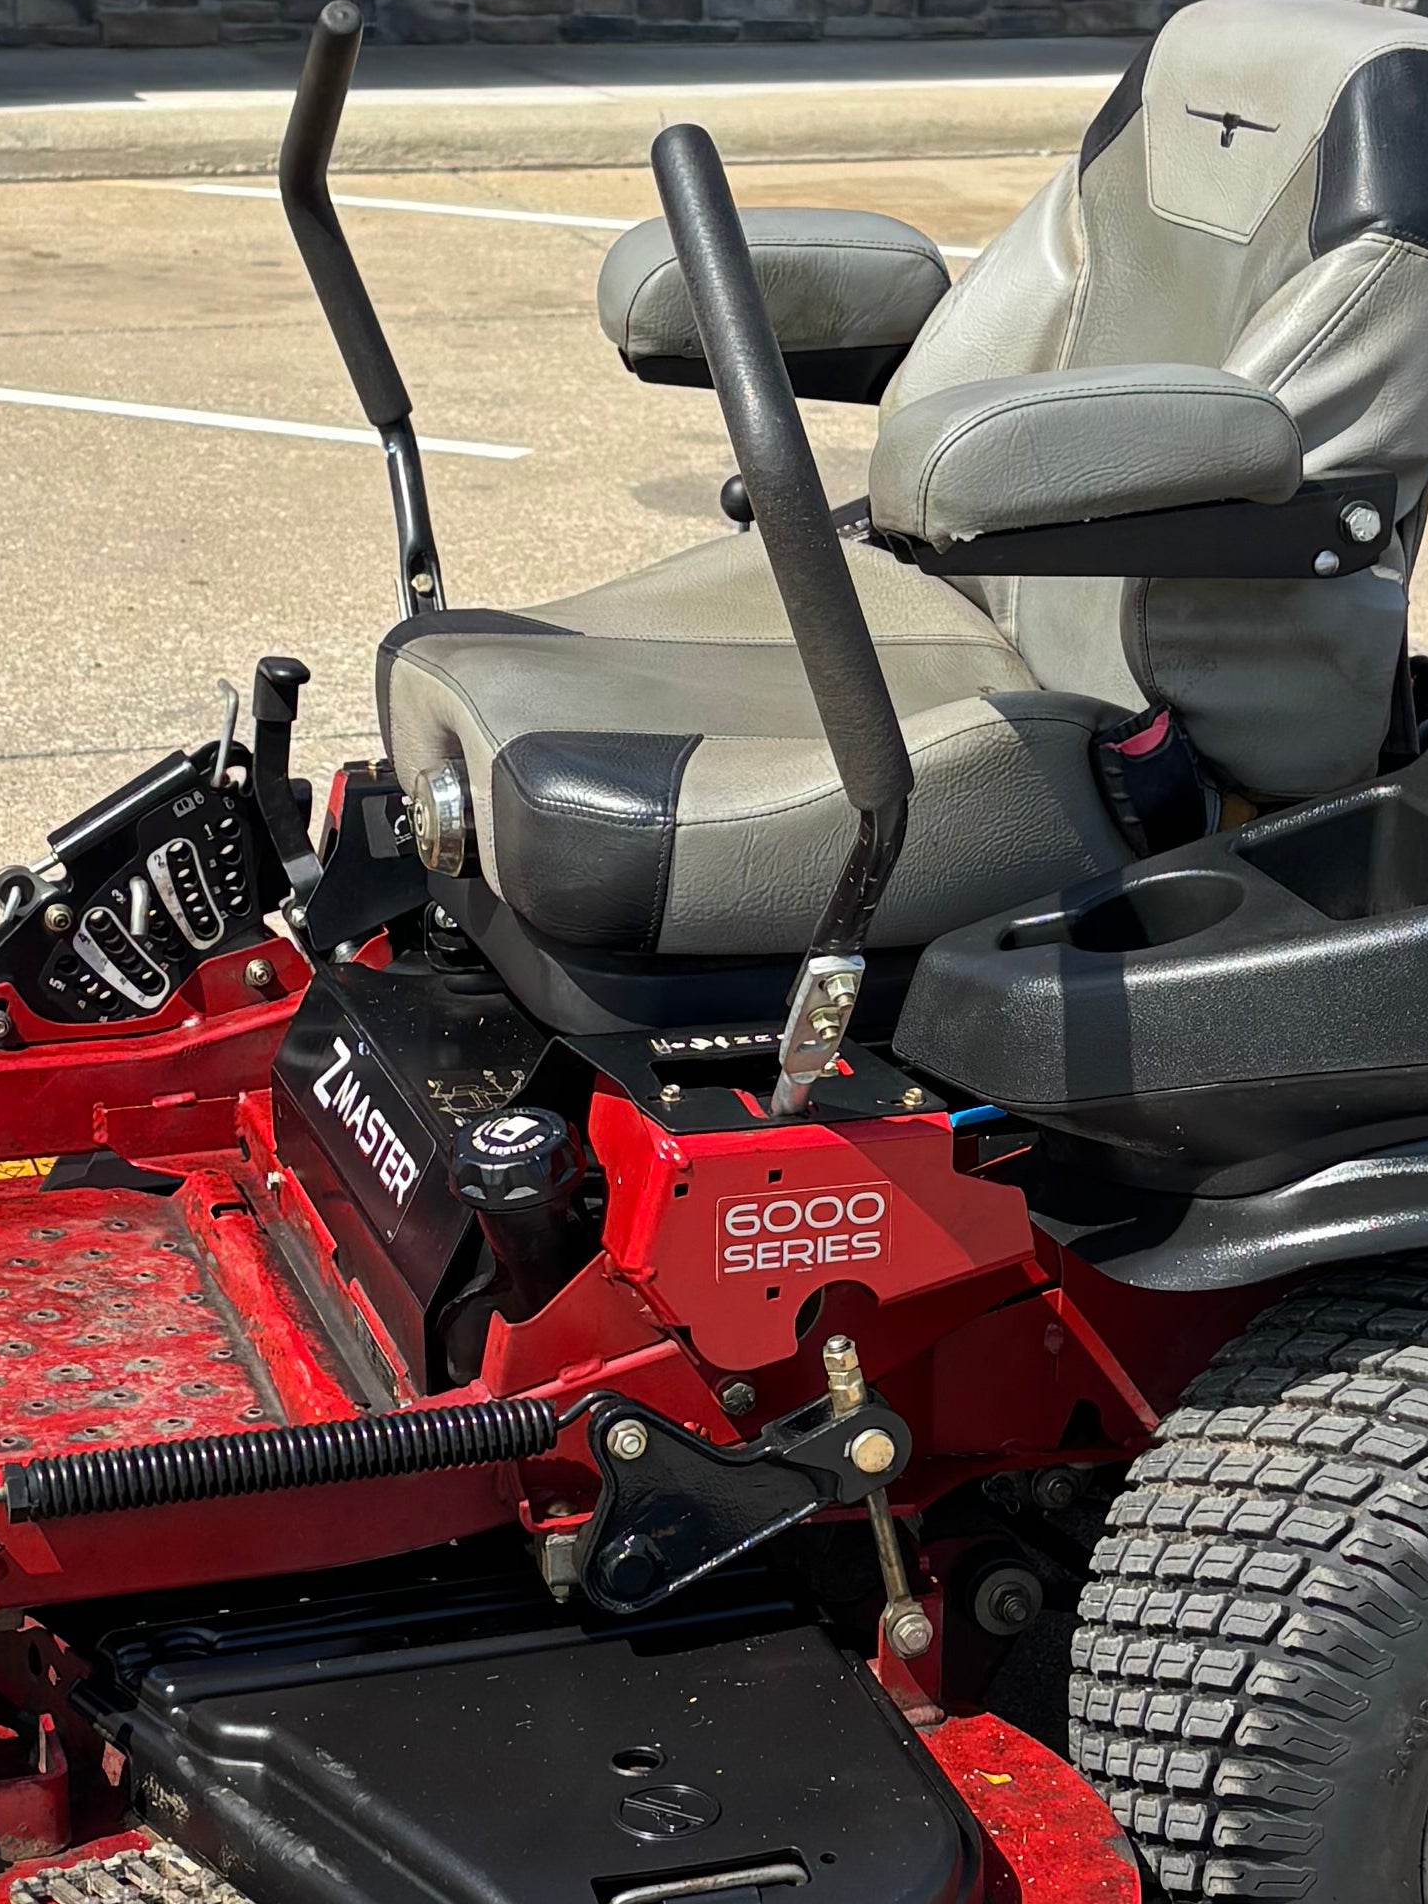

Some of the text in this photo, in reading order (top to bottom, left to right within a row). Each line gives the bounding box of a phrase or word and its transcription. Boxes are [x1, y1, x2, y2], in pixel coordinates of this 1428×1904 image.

[313, 1036, 417, 1208] Z MASTER
[725, 1191, 885, 1237] 6000
[723, 1231, 881, 1274] SERIES
